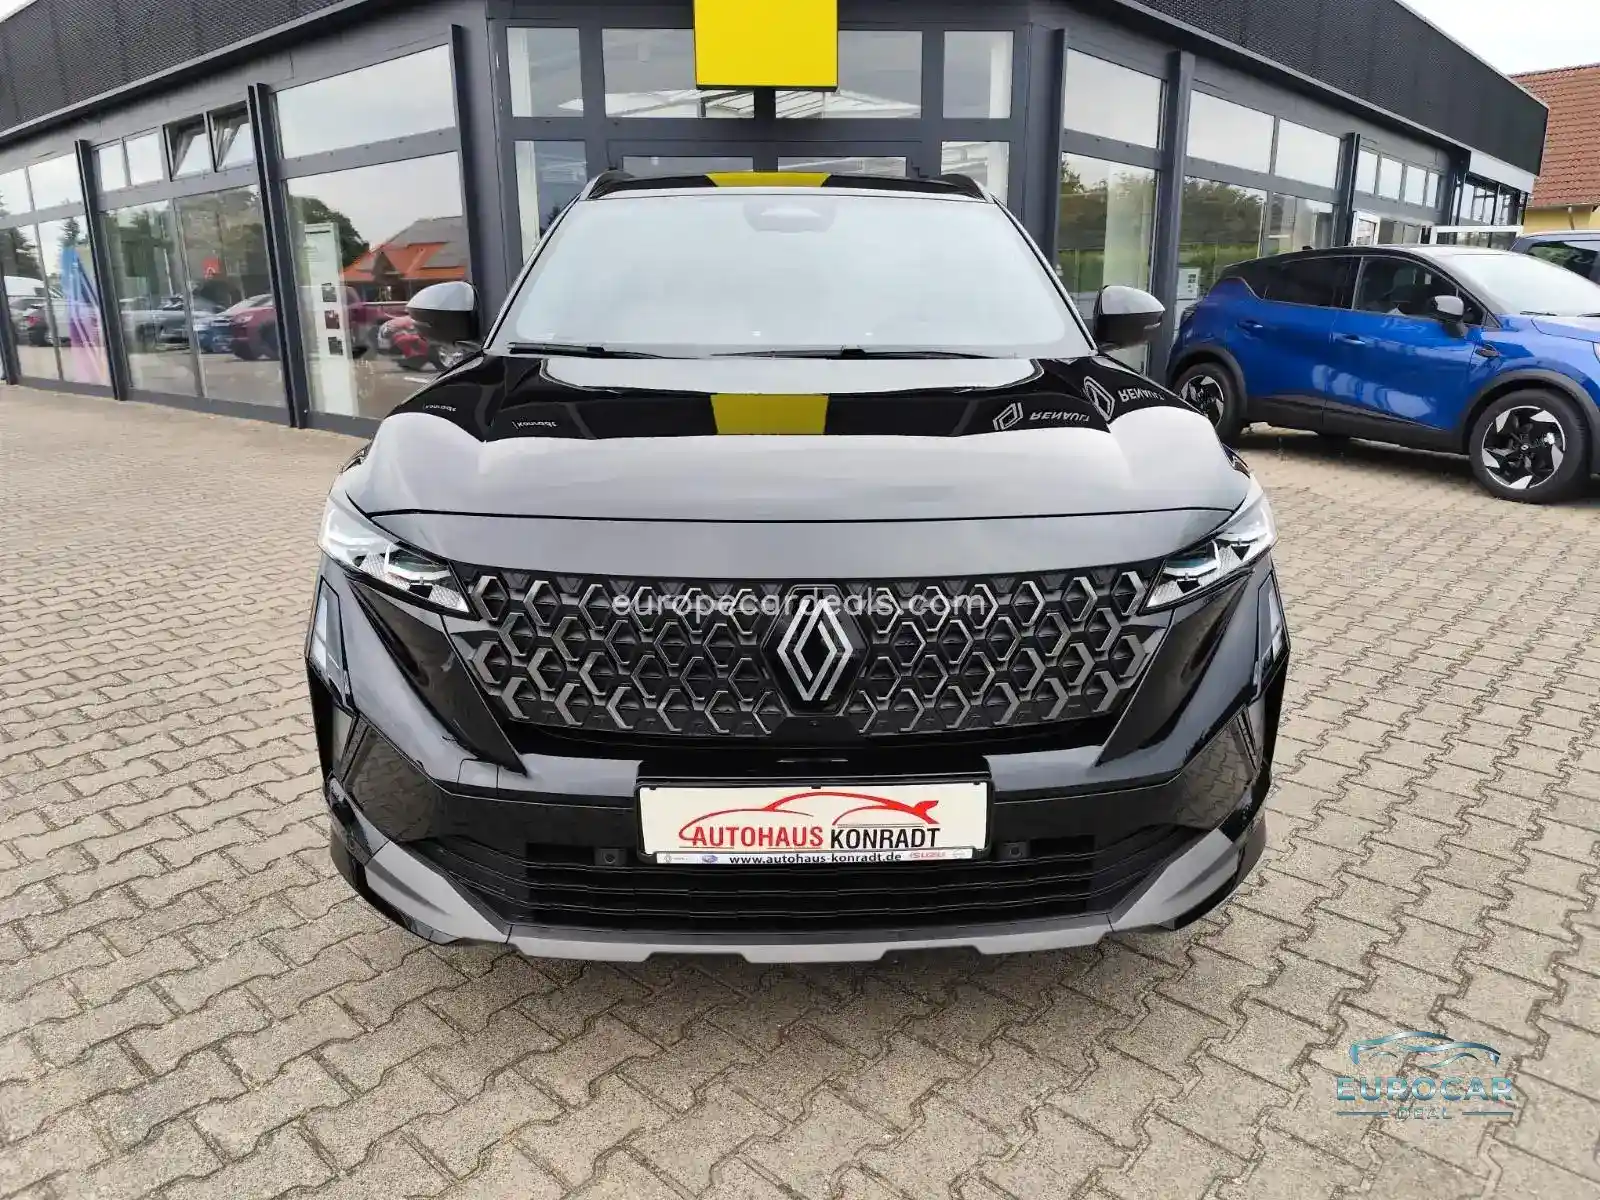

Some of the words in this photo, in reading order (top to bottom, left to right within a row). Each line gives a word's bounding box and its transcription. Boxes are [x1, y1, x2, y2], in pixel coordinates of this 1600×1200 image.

[691, 825, 824, 849] AUTOHAUS
[830, 827, 941, 850] KONRADT
[729, 851, 902, 865] www.autohaus-konradt.de
